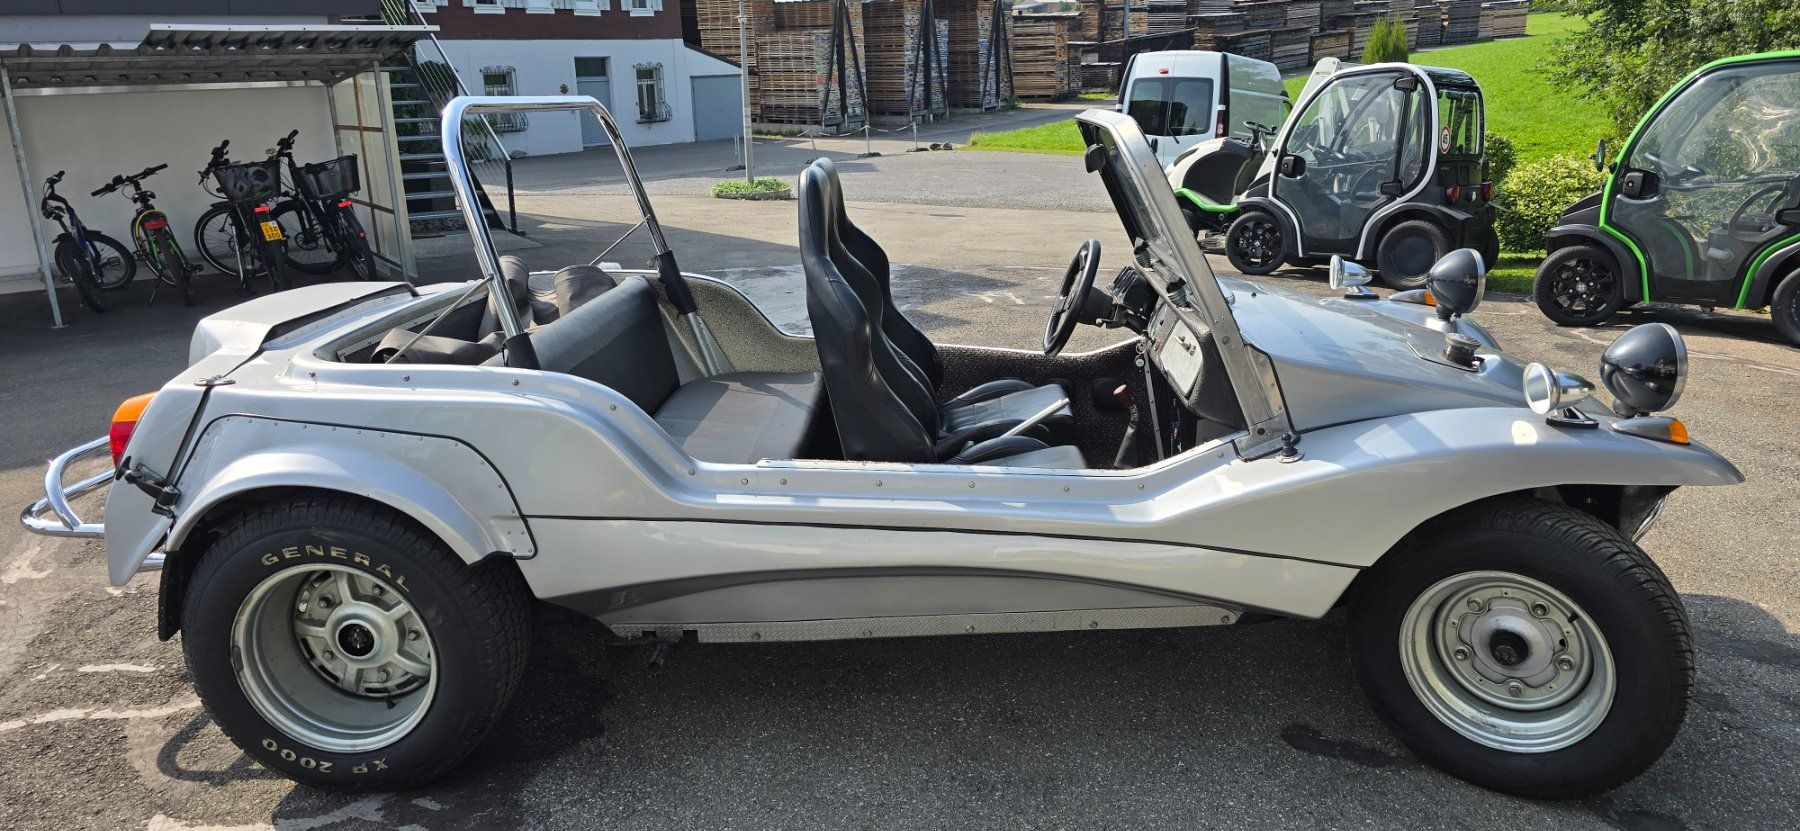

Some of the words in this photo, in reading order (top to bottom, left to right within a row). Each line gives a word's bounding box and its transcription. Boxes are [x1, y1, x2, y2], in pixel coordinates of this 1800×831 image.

[261, 545, 410, 593] GENERAL
[262, 738, 334, 773] 2000
[352, 758, 389, 774] XP
